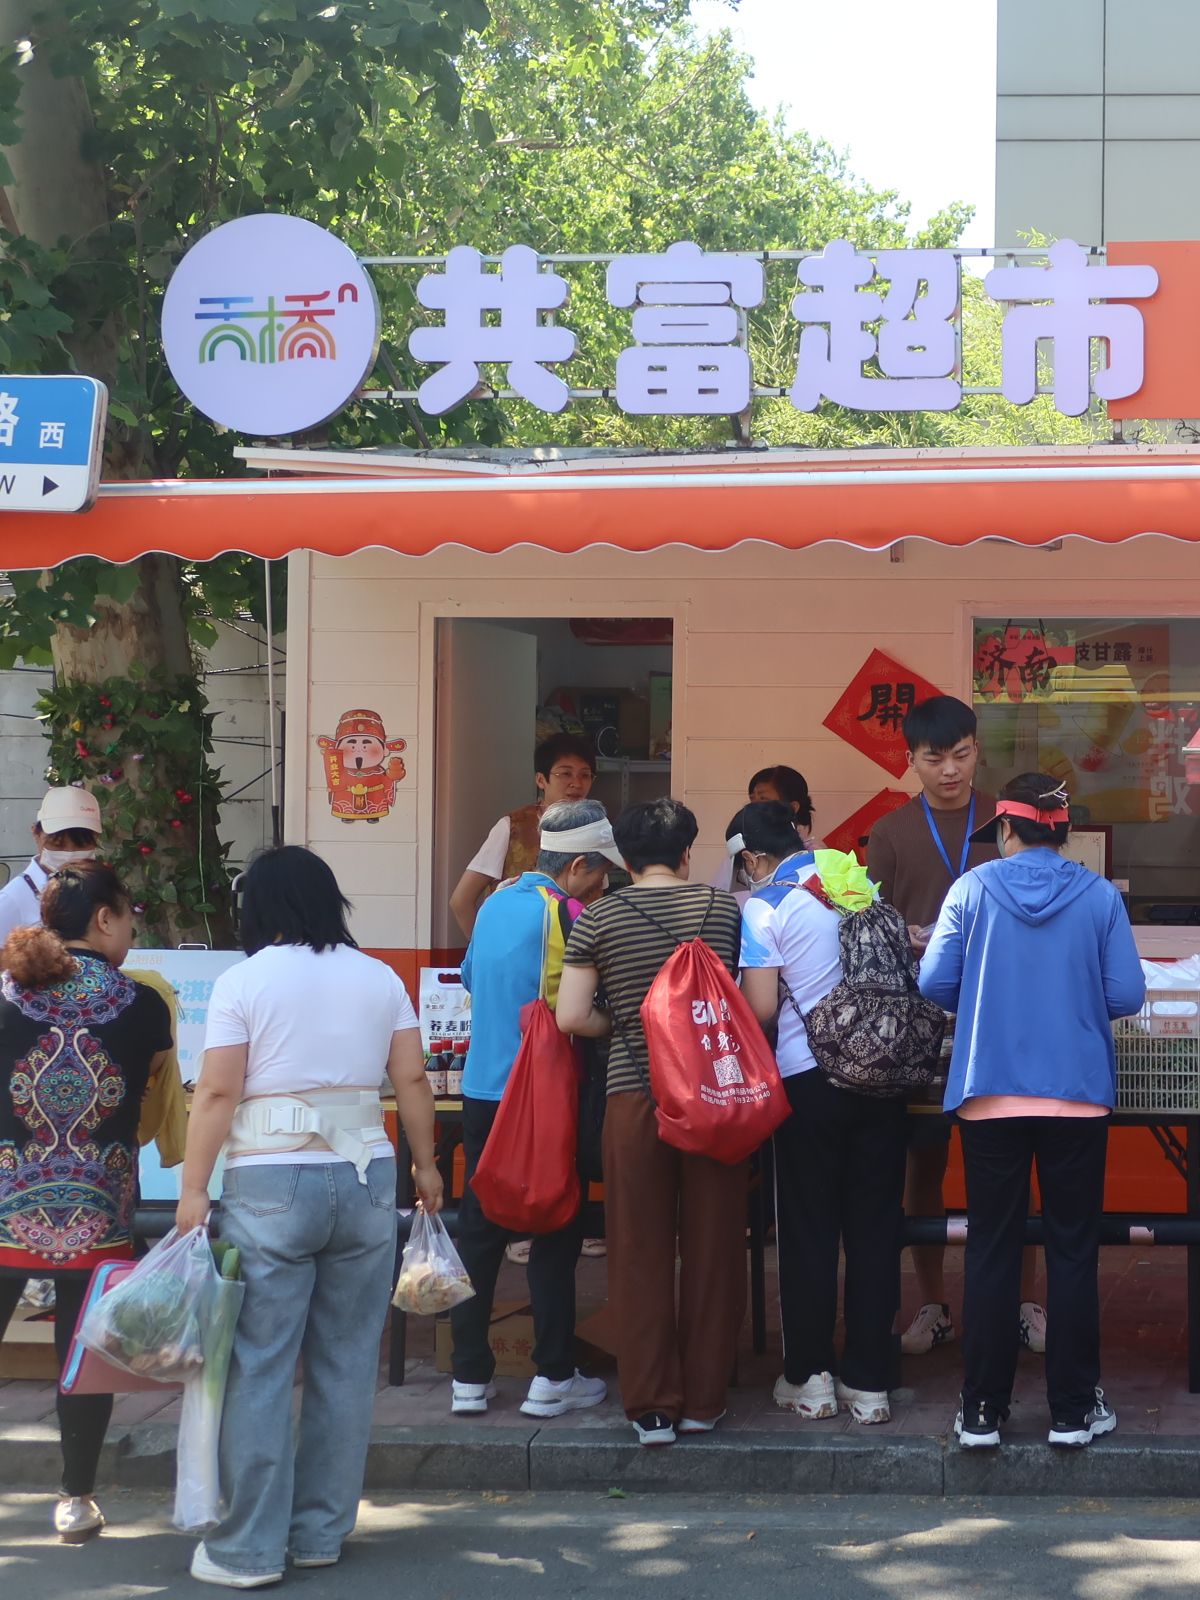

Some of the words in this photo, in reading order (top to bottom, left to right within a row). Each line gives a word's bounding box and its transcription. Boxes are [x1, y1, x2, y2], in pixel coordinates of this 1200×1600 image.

[408, 239, 1160, 416] 共富超市
[39, 421, 66, 449] 西
[978, 644, 1058, 690] 济南
